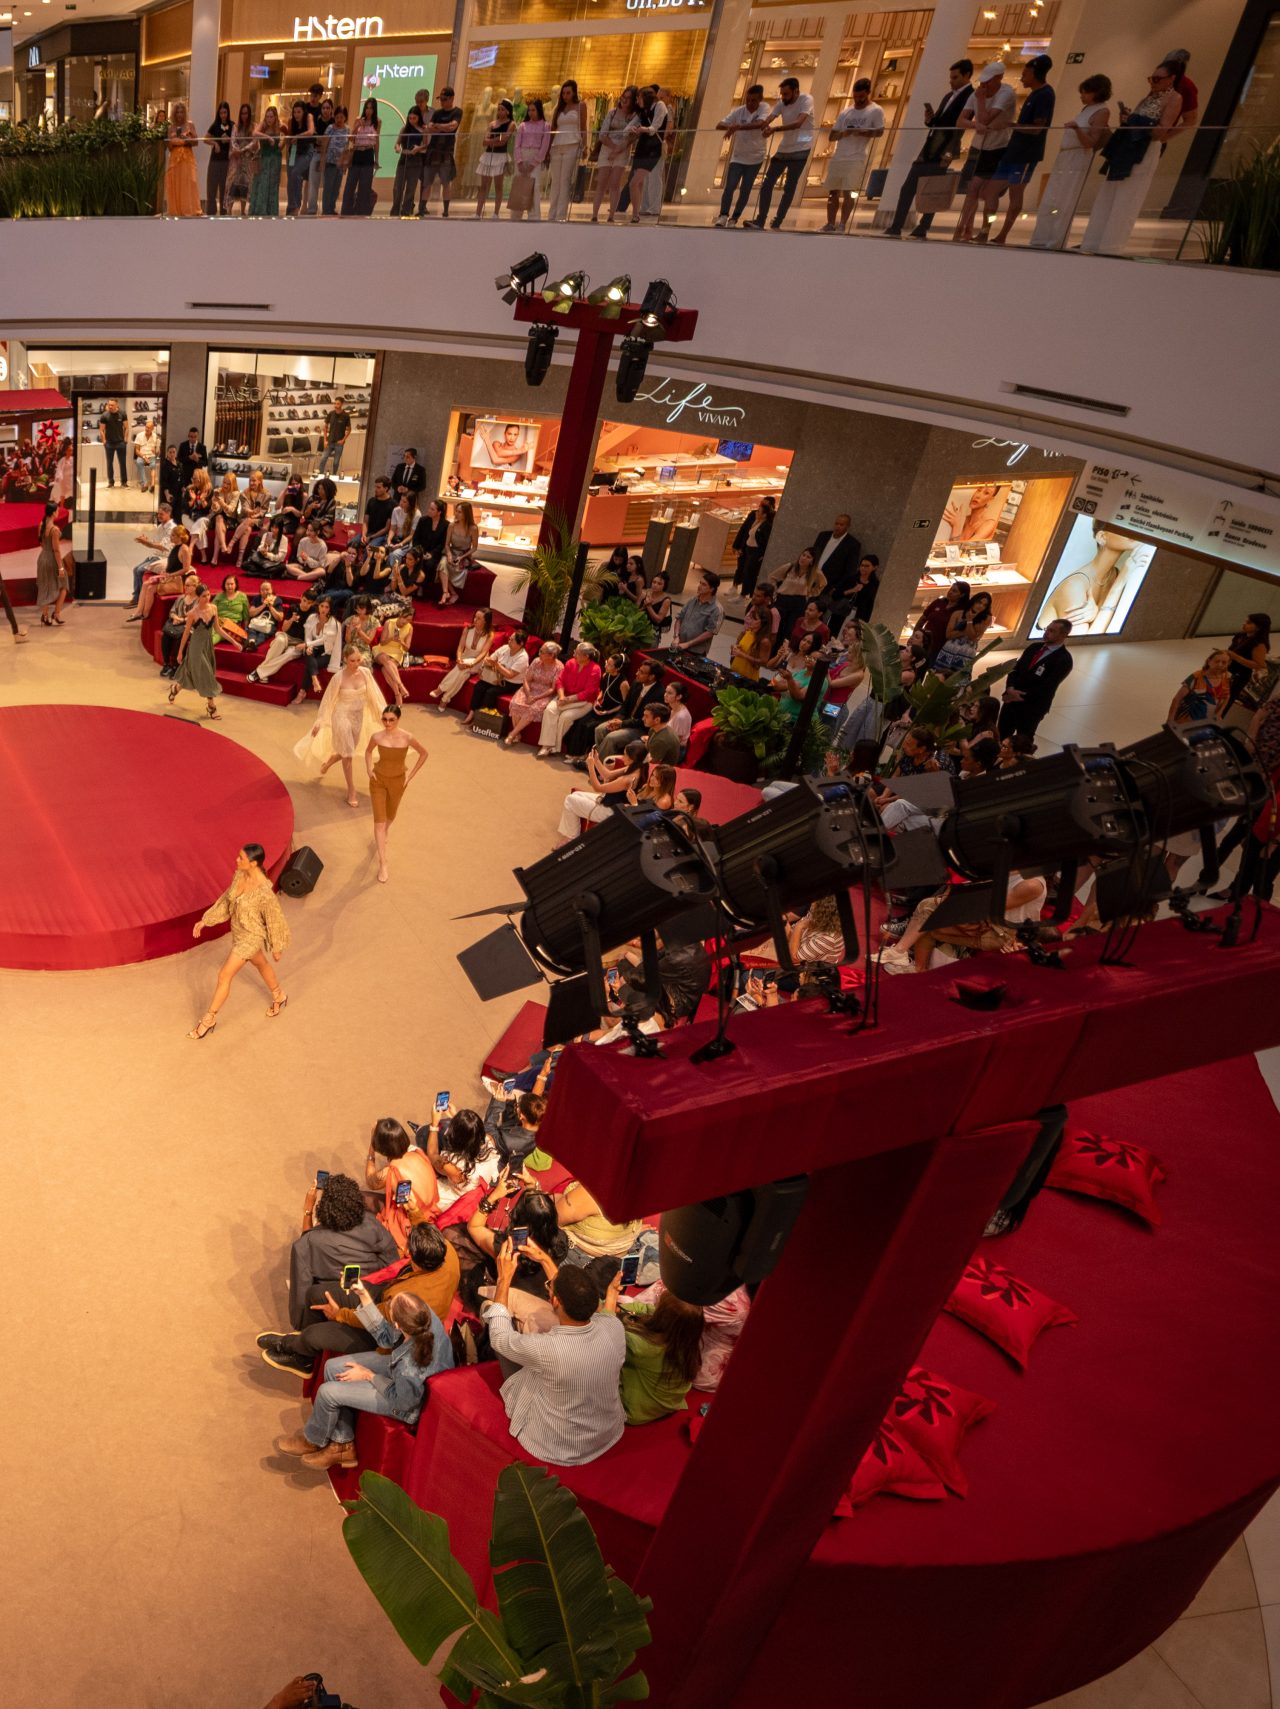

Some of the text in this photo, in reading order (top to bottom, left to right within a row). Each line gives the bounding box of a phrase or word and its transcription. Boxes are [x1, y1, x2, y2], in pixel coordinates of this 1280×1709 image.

[634, 377, 745, 423] Life
[698, 411, 738, 427] VIVARA
[1092, 466, 1110, 477] PISO
[472, 725, 500, 740] Usaflex
